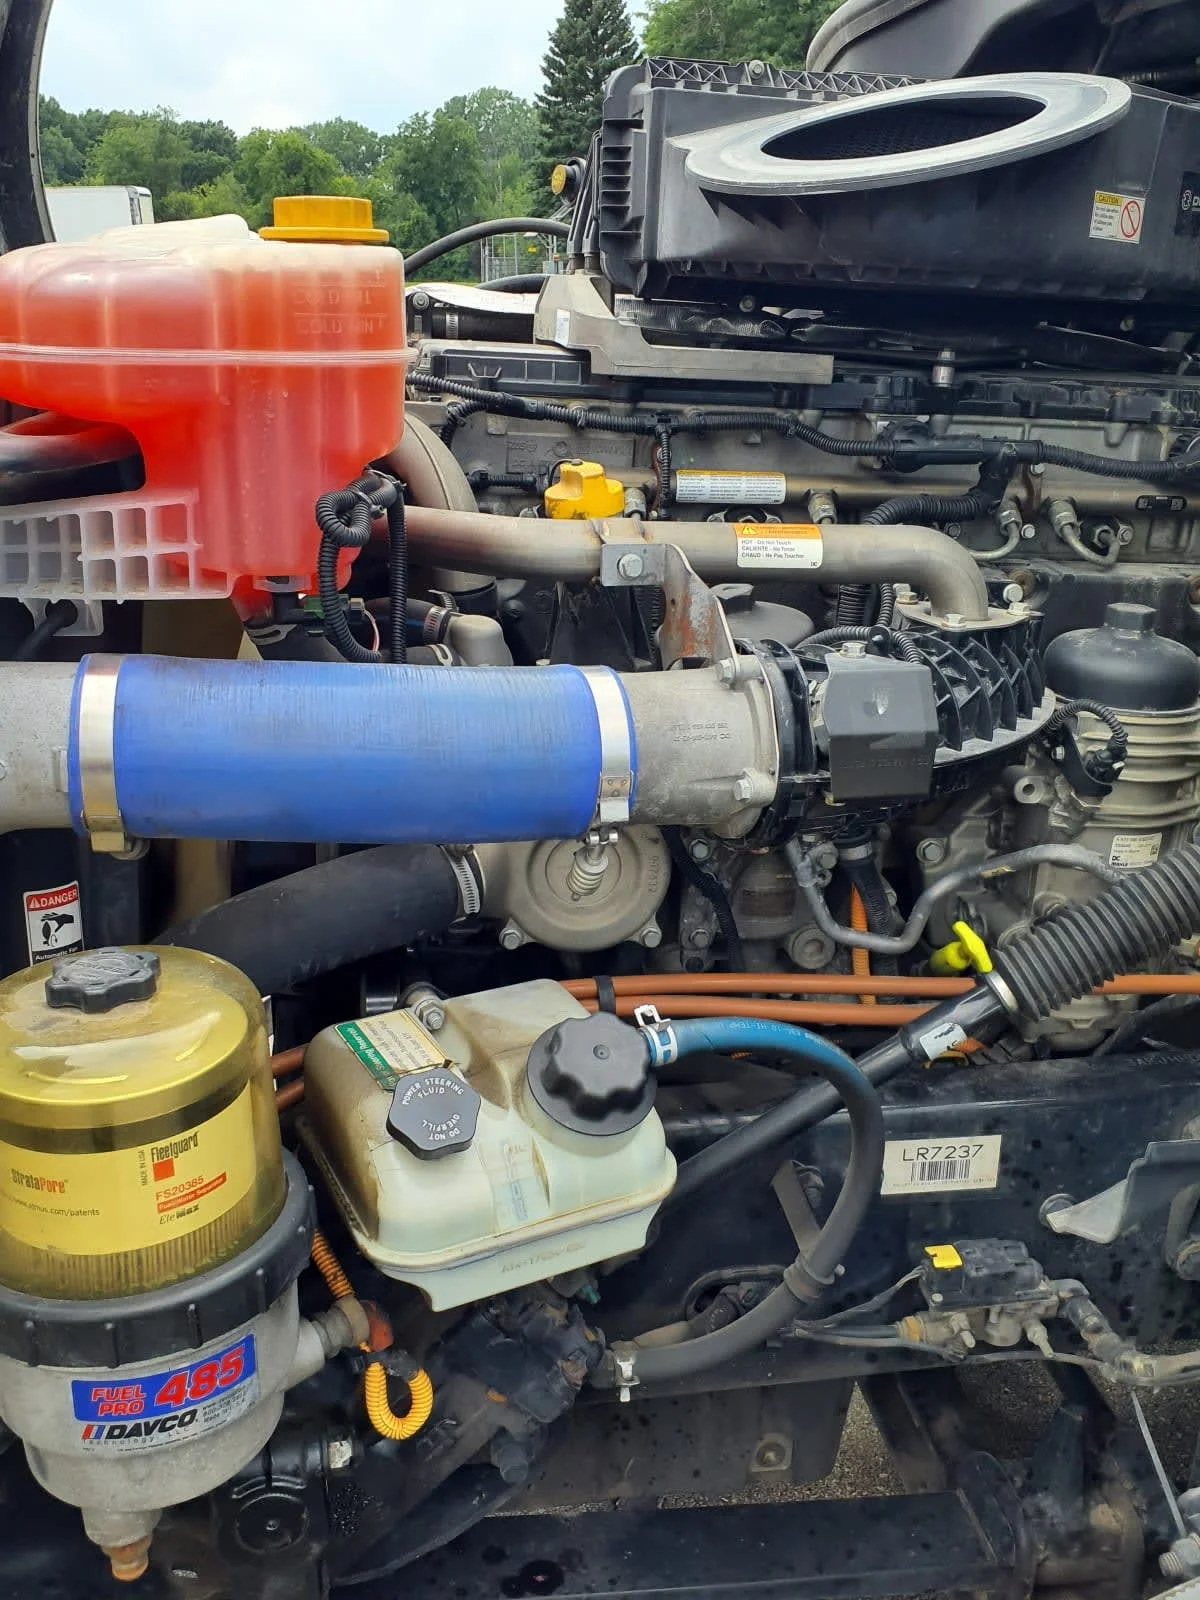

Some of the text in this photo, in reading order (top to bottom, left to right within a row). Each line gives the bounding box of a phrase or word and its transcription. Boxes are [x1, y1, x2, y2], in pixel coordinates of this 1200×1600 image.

[40, 890, 78, 908] DANGER
[35, 949, 68, 961] Automatic
[402, 1077, 464, 1105] POWER STEERING
[417, 1086, 446, 1099] FLUID
[421, 1113, 461, 1132] OVERFILL
[428, 1126, 461, 1142] DO NOT
[151, 1131, 200, 1163] Fleetguard
[903, 1144, 984, 1162] LR7237
[155, 1344, 246, 1407] 485
[91, 1384, 146, 1402] FUEL
[98, 1402, 145, 1416] PRO
[105, 1408, 198, 1440] DAVCO
